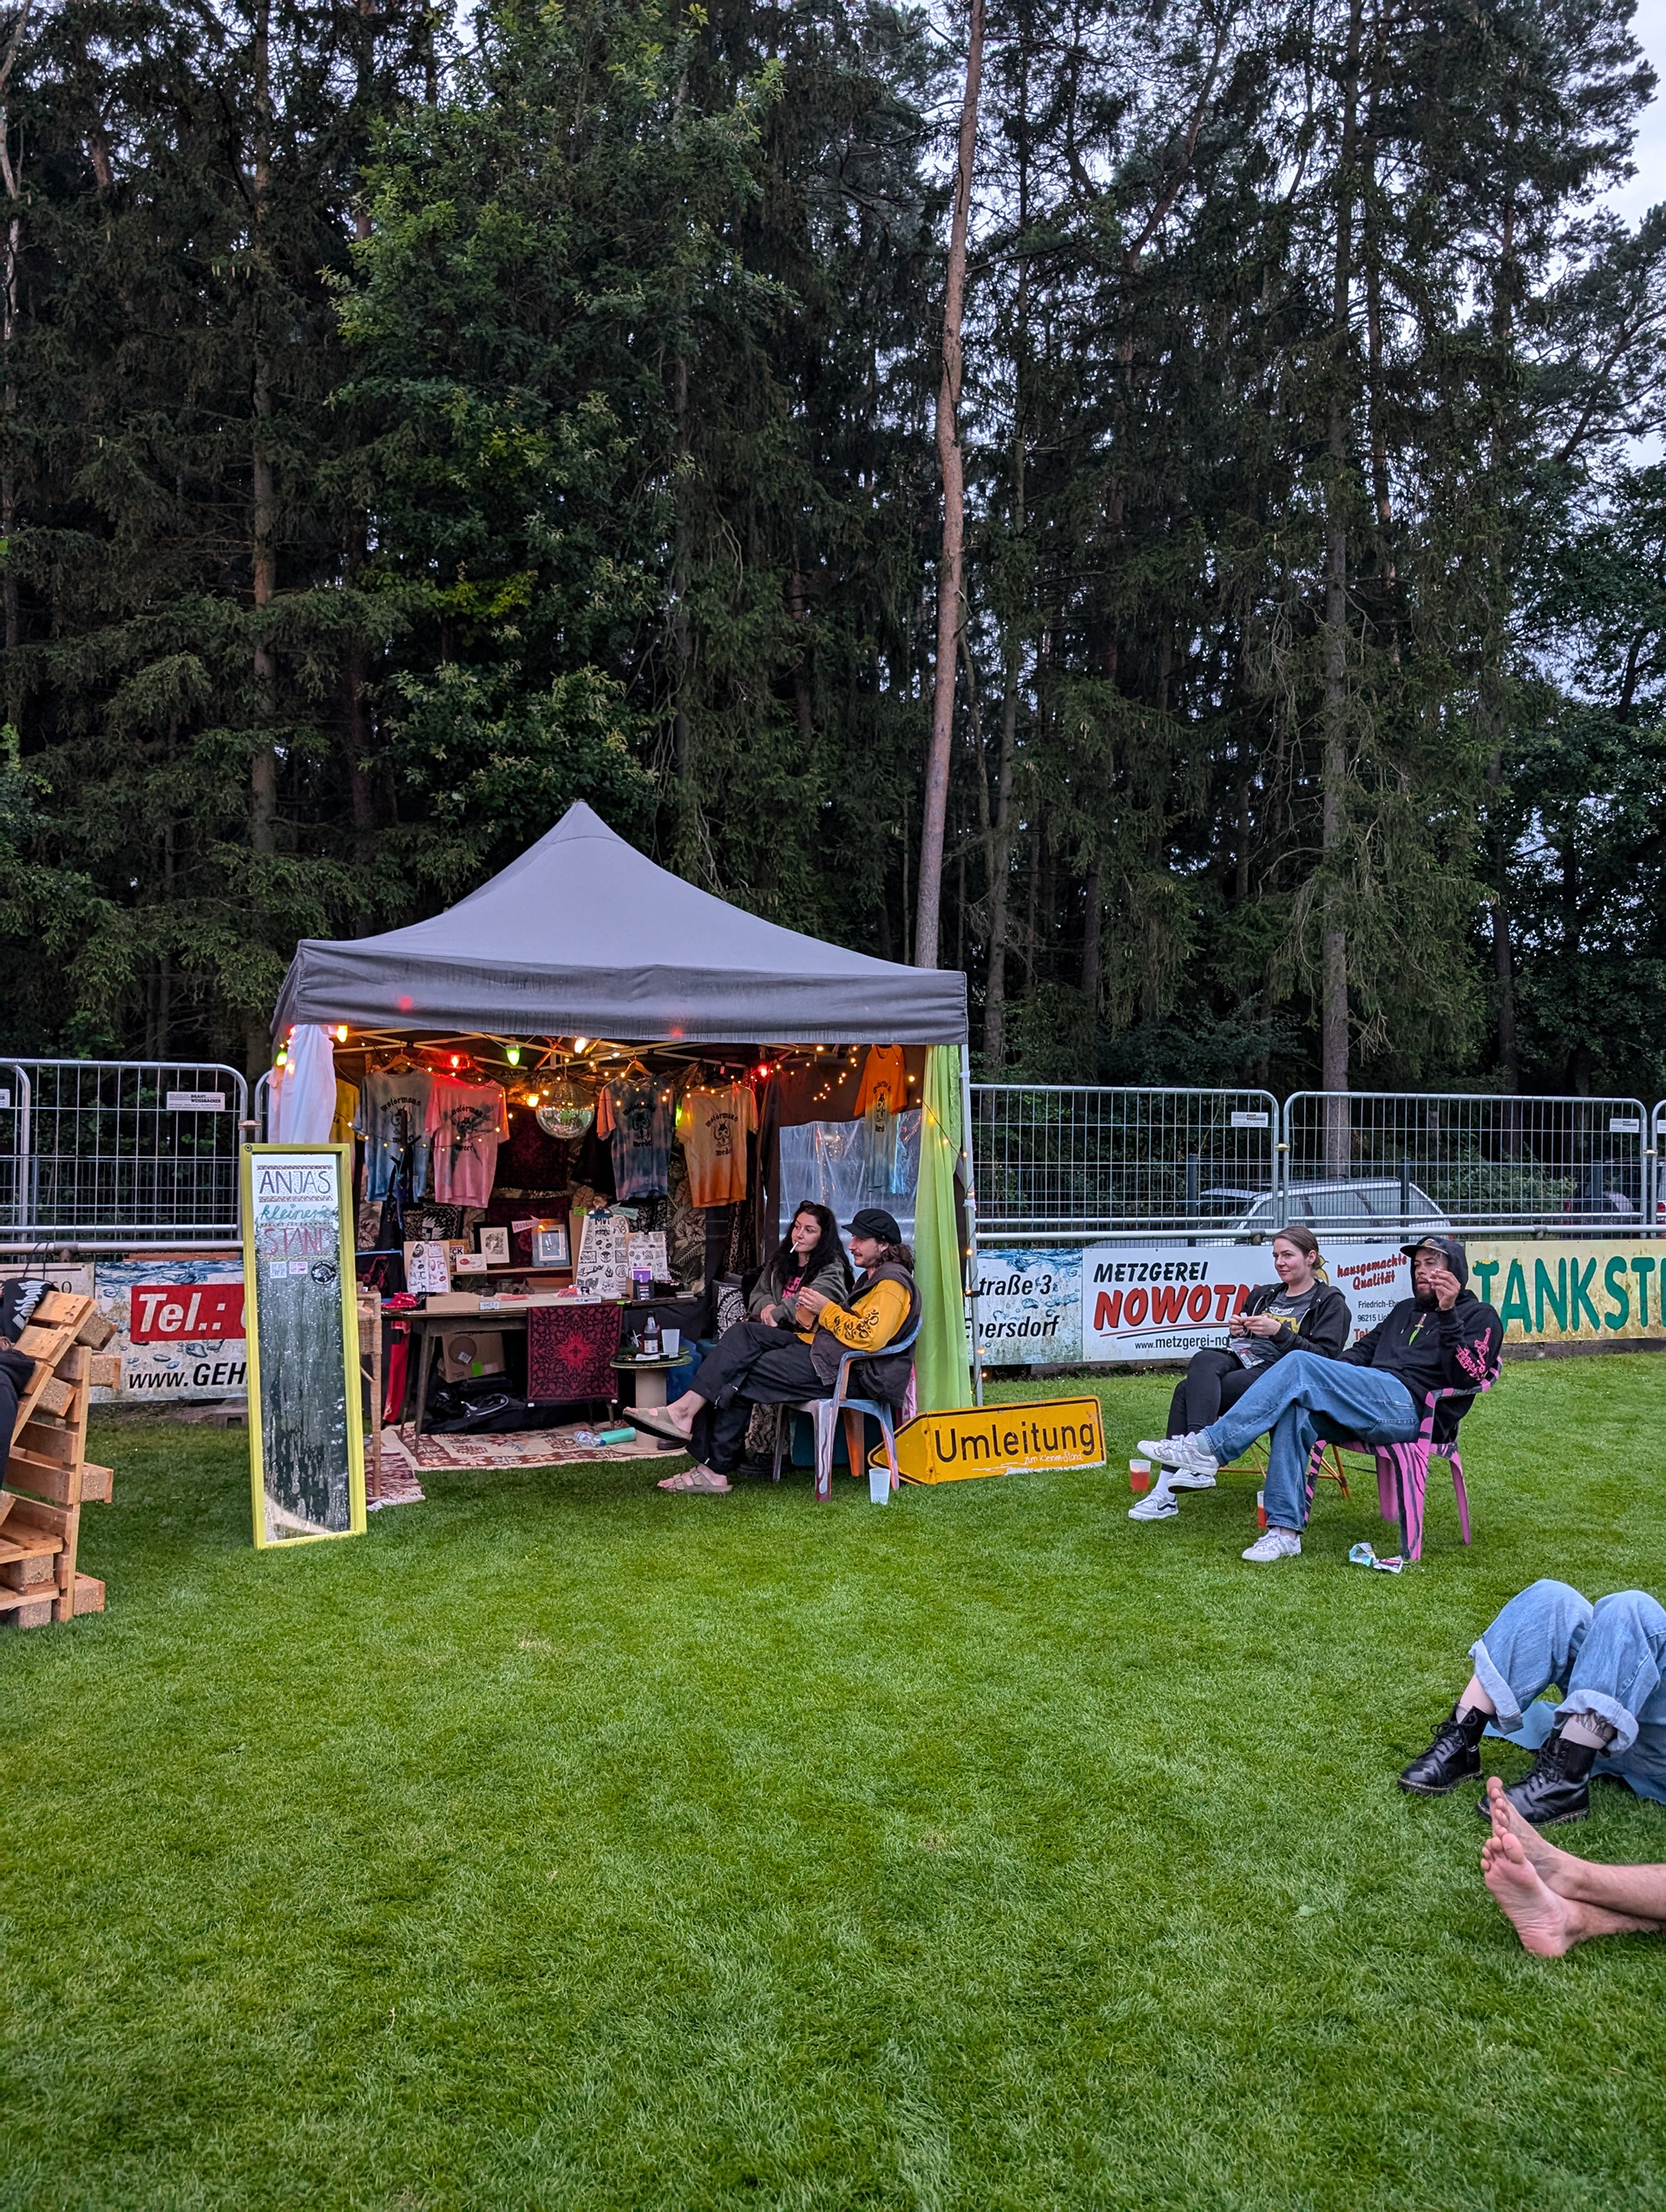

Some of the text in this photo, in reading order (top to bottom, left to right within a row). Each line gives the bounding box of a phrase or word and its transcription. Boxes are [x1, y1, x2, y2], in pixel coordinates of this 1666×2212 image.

[259, 1171, 331, 1194] ANJAS
[1093, 1261, 1209, 1283] METZGEREI
[1337, 1253, 1407, 1278] hausgemachte
[979, 1273, 1053, 1296] traße 3
[1353, 1270, 1395, 1290] Qualität
[1135, 1334, 1230, 1350] www.metzgerei-no
[129, 1362, 248, 1390] www.GEH
[935, 1421, 1095, 1463] Umleitung
